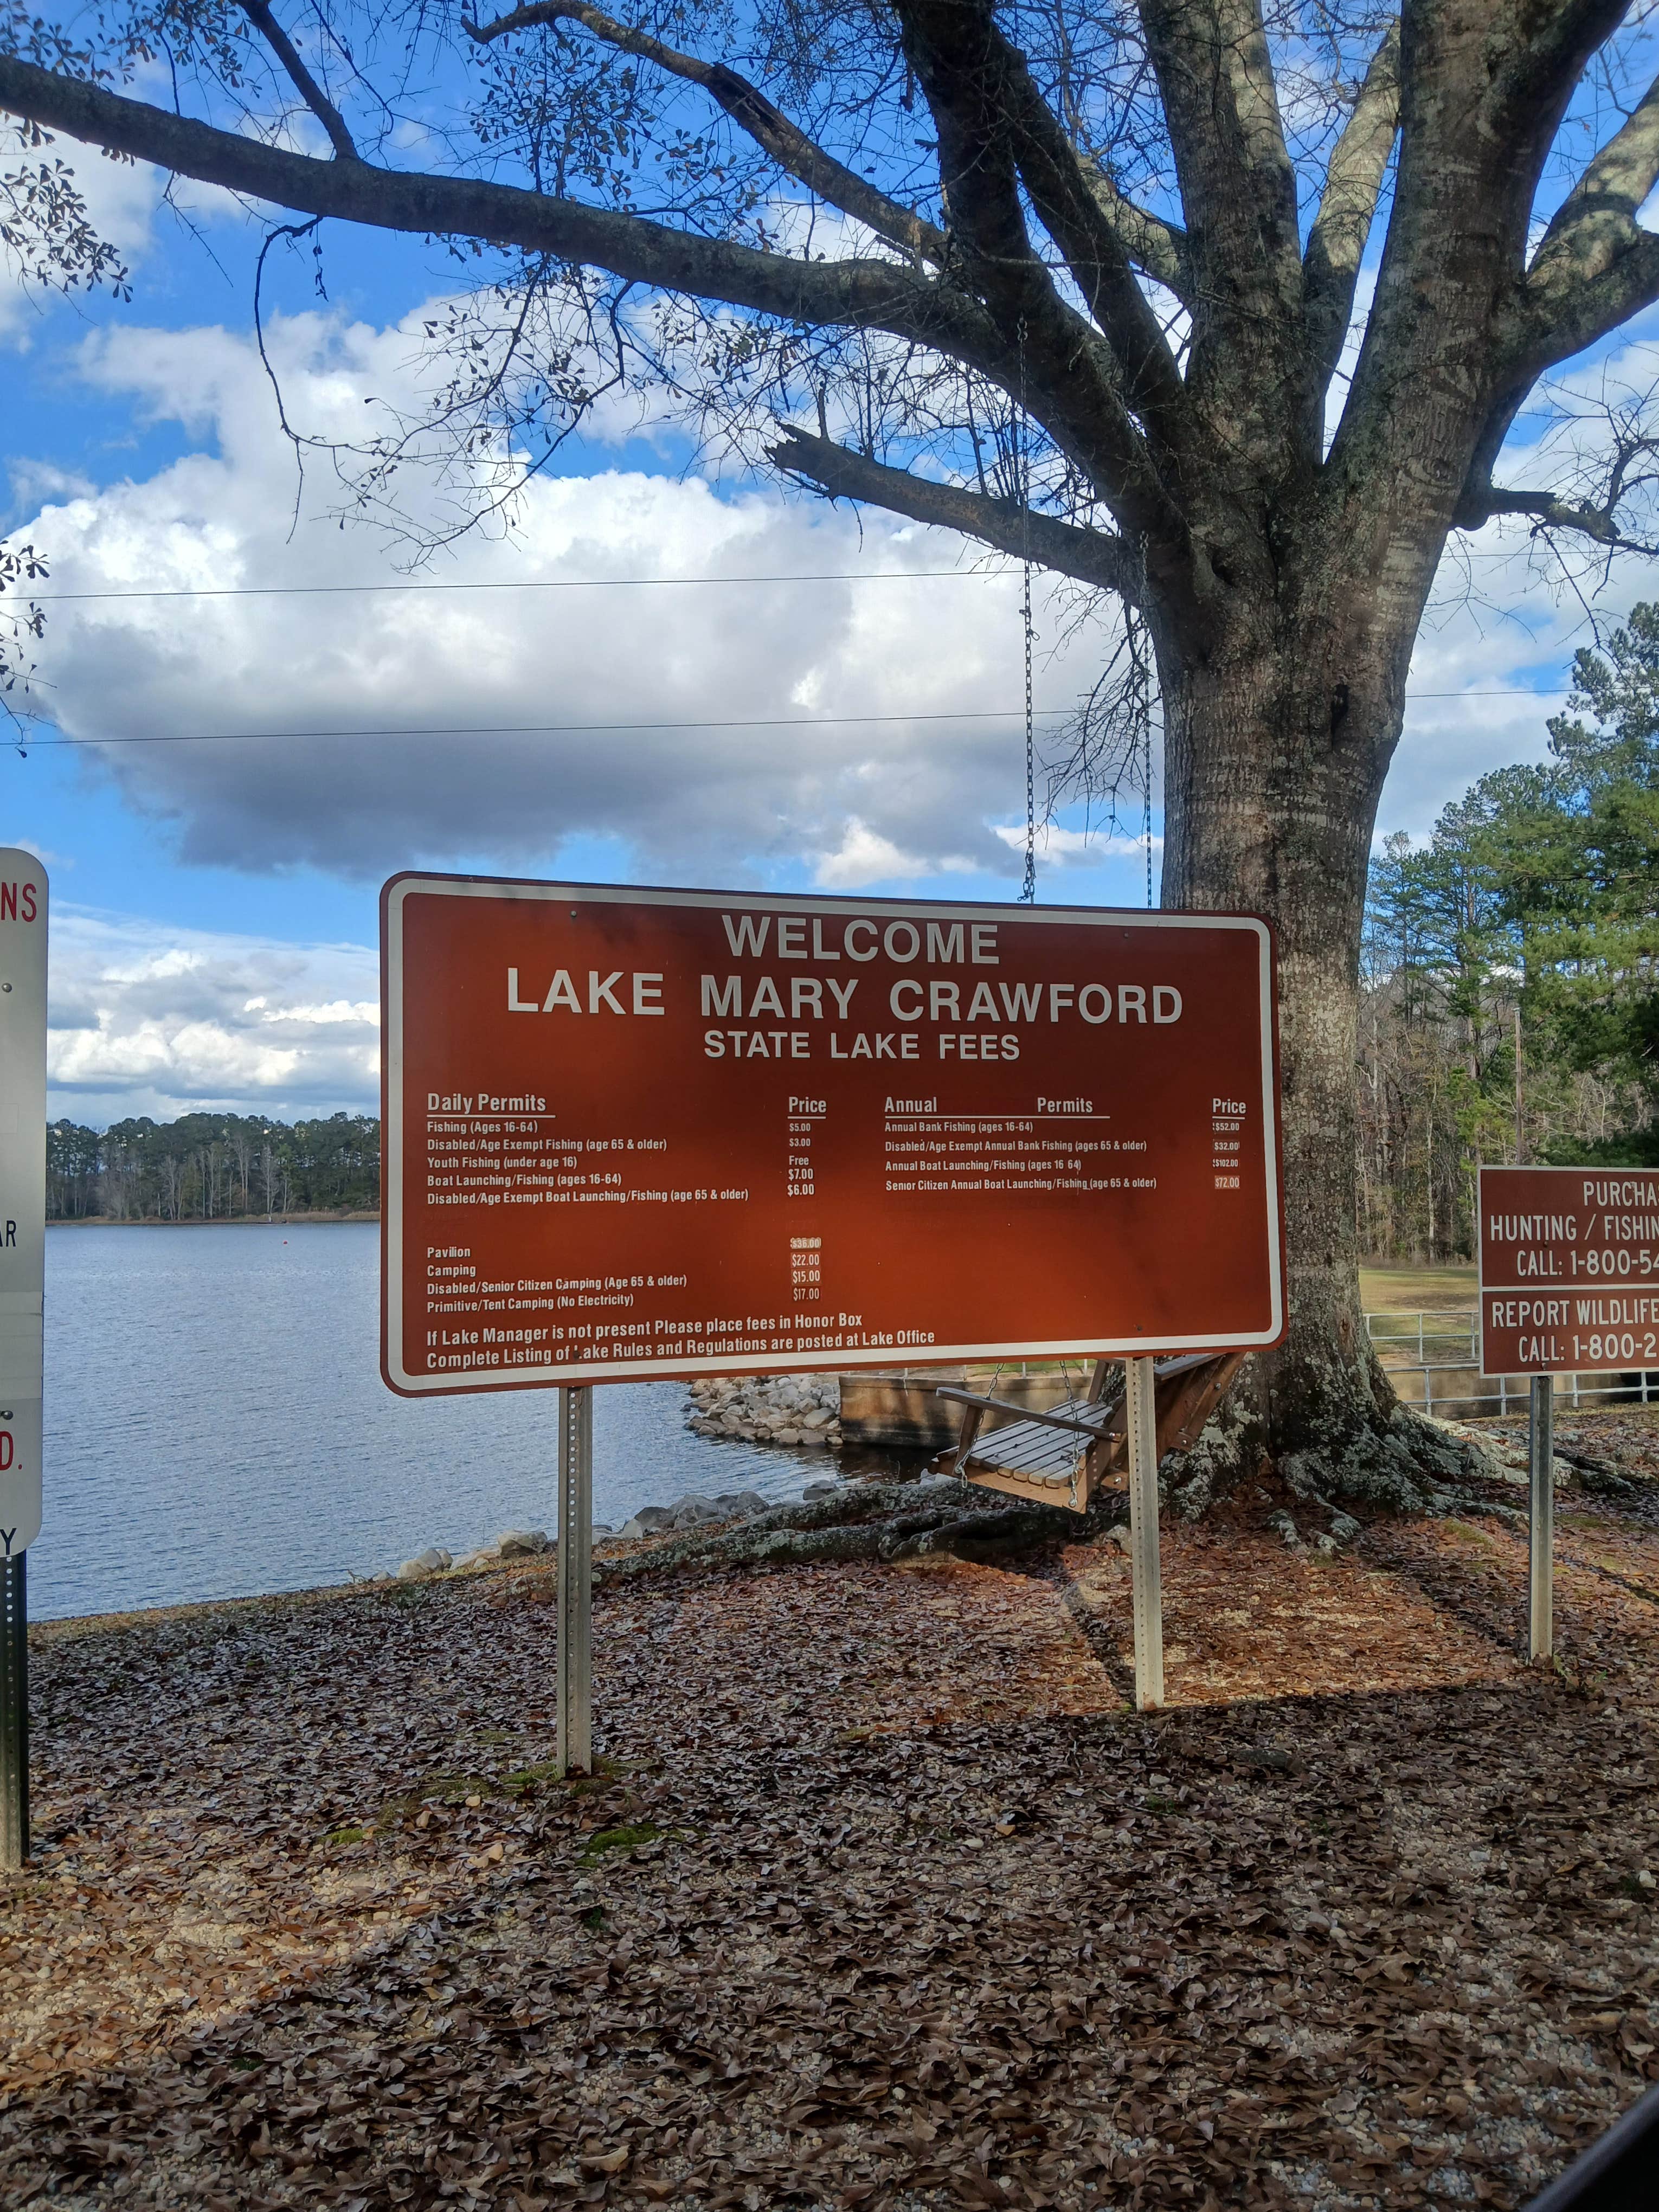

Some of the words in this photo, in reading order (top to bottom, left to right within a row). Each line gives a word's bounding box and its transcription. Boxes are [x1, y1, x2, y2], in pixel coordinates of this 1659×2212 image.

[722, 915, 999, 964] WELCOME
[508, 968, 664, 1015] LAKE
[702, 975, 858, 1019] MARY
[890, 980, 1182, 1024] CRAWFORD
[705, 1030, 810, 1058] STATE
[831, 1033, 919, 1058] LAKE
[940, 1034, 1019, 1060] FEES
[428, 1094, 472, 1114] Daily
[479, 1094, 545, 1111] Permits
[789, 1097, 826, 1113] Price
[885, 1097, 937, 1112] Annual
[1038, 1097, 1092, 1113] Permits
[1213, 1098, 1246, 1114] Price
[428, 1122, 466, 1134] Fishing
[471, 1122, 500, 1134] (Ages
[504, 1120, 537, 1133] 16-64)
[789, 1123, 811, 1131] $5.00
[885, 1122, 916, 1131] Annual
[919, 1122, 942, 1131] Bank
[944, 1122, 975, 1133] Fishing
[979, 1122, 1002, 1133] (ages
[1005, 1122, 1033, 1133] 16-64)
[1215, 1122, 1239, 1131] $52.00
[428, 1139, 500, 1152] Disabled/Age
[504, 1139, 543, 1152] Exempt
[546, 1139, 582, 1152] Fishing
[587, 1139, 609, 1152] (age
[612, 1139, 623, 1149] 65
[627, 1139, 634, 1149] &
[638, 1139, 666, 1151] older)
[789, 1138, 810, 1147] $3.00
[885, 1140, 946, 1153] Disabled/Age
[949, 1141, 982, 1152] Exempt
[985, 1141, 1015, 1150] Annual
[1018, 1141, 1039, 1150] Bank
[1042, 1141, 1072, 1152] Fishing
[1076, 1141, 1098, 1152] (ages
[1101, 1141, 1111, 1150] 65
[1114, 1141, 1120, 1149] &
[1123, 1141, 1146, 1152] older)
[1214, 1142, 1238, 1150] $32.00
[428, 1157, 458, 1168] Youth
[462, 1157, 500, 1169] Fishing
[504, 1156, 537, 1169] (under
[540, 1159, 558, 1169] age
[562, 1156, 577, 1169] 16)
[789, 1155, 809, 1165] Free
[885, 1161, 917, 1171] Annual
[920, 1161, 941, 1171] Boat
[943, 1160, 1025, 1172] Launching/Fishing
[1028, 1160, 1051, 1171] (ages
[1215, 1159, 1238, 1167] $102.00
[428, 1175, 453, 1186] Boat
[456, 1174, 554, 1187] Launching/Fishing
[557, 1174, 586, 1186] (ages
[589, 1173, 621, 1186] 16-64)
[789, 1168, 813, 1181] $7.00
[886, 1181, 916, 1191] Senior
[918, 1180, 948, 1190] Citizen
[951, 1180, 981, 1189] Annual
[985, 1180, 1004, 1189] Boat
[1007, 1179, 1089, 1190] Launching/Fishing
[1090, 1179, 1108, 1189] (age
[1110, 1178, 1121, 1187] 65
[1124, 1178, 1129, 1187] &
[1133, 1178, 1156, 1189] older)
[1215, 1177, 1239, 1188] $72.00
[428, 1193, 500, 1205] Disabled/Age
[504, 1192, 543, 1204] Exempt
[546, 1192, 570, 1202] Boat
[574, 1190, 667, 1203] Launching/Fishing
[671, 1189, 692, 1202] (age
[695, 1189, 707, 1199] 65
[711, 1189, 717, 1199] &
[721, 1189, 748, 1201] older)
[788, 1184, 814, 1197] $6.00
[1584, 1181, 1659, 1206] PURCHA
[1491, 1216, 1576, 1240] HUNTING
[428, 1246, 470, 1258] Pavilion
[792, 1253, 820, 1268] $22.00
[1517, 1250, 1562, 1276] CALL:
[428, 1264, 475, 1277] Camping
[792, 1270, 820, 1284] $15.00
[428, 1281, 515, 1294] Disabled/Senior
[518, 1279, 552, 1291] Citizen
[556, 1278, 601, 1290] Camping
[604, 1277, 628, 1291] (Age
[631, 1276, 643, 1287] 65
[647, 1276, 654, 1286] &
[658, 1275, 686, 1287] older)
[793, 1287, 820, 1301] $17.00
[428, 1299, 505, 1313] Primitive/Tent
[509, 1297, 554, 1310] Camping
[557, 1296, 575, 1309] (No
[578, 1294, 633, 1306] Electricity)
[1493, 1301, 1570, 1327] REPORT
[1577, 1298, 1659, 1324] WILDLIFE
[428, 1331, 437, 1346] If
[442, 1329, 478, 1345] Lake
[484, 1328, 548, 1343] Manager
[552, 1325, 563, 1339] is
[569, 1324, 591, 1338] not
[596, 1322, 650, 1340] present
[655, 1320, 702, 1334] Please
[707, 1318, 742, 1335] place
[747, 1317, 775, 1330] fees
[780, 1315, 790, 1329] in
[795, 1314, 834, 1328] Honor
[839, 1313, 862, 1326] Box
[427, 1351, 499, 1369] Complete
[504, 1348, 551, 1364] Listing
[556, 1346, 569, 1360] of
[614, 1342, 652, 1357] Rules
[657, 1340, 682, 1355] and
[687, 1338, 767, 1355] Regulations
[771, 1339, 793, 1349] are
[798, 1333, 842, 1352] posted
[847, 1333, 858, 1346] at
[863, 1332, 893, 1345] Lake
[897, 1330, 934, 1344] Office
[1519, 1336, 1564, 1362] CALL:
[1573, 1333, 1656, 1360] 1-800-2
